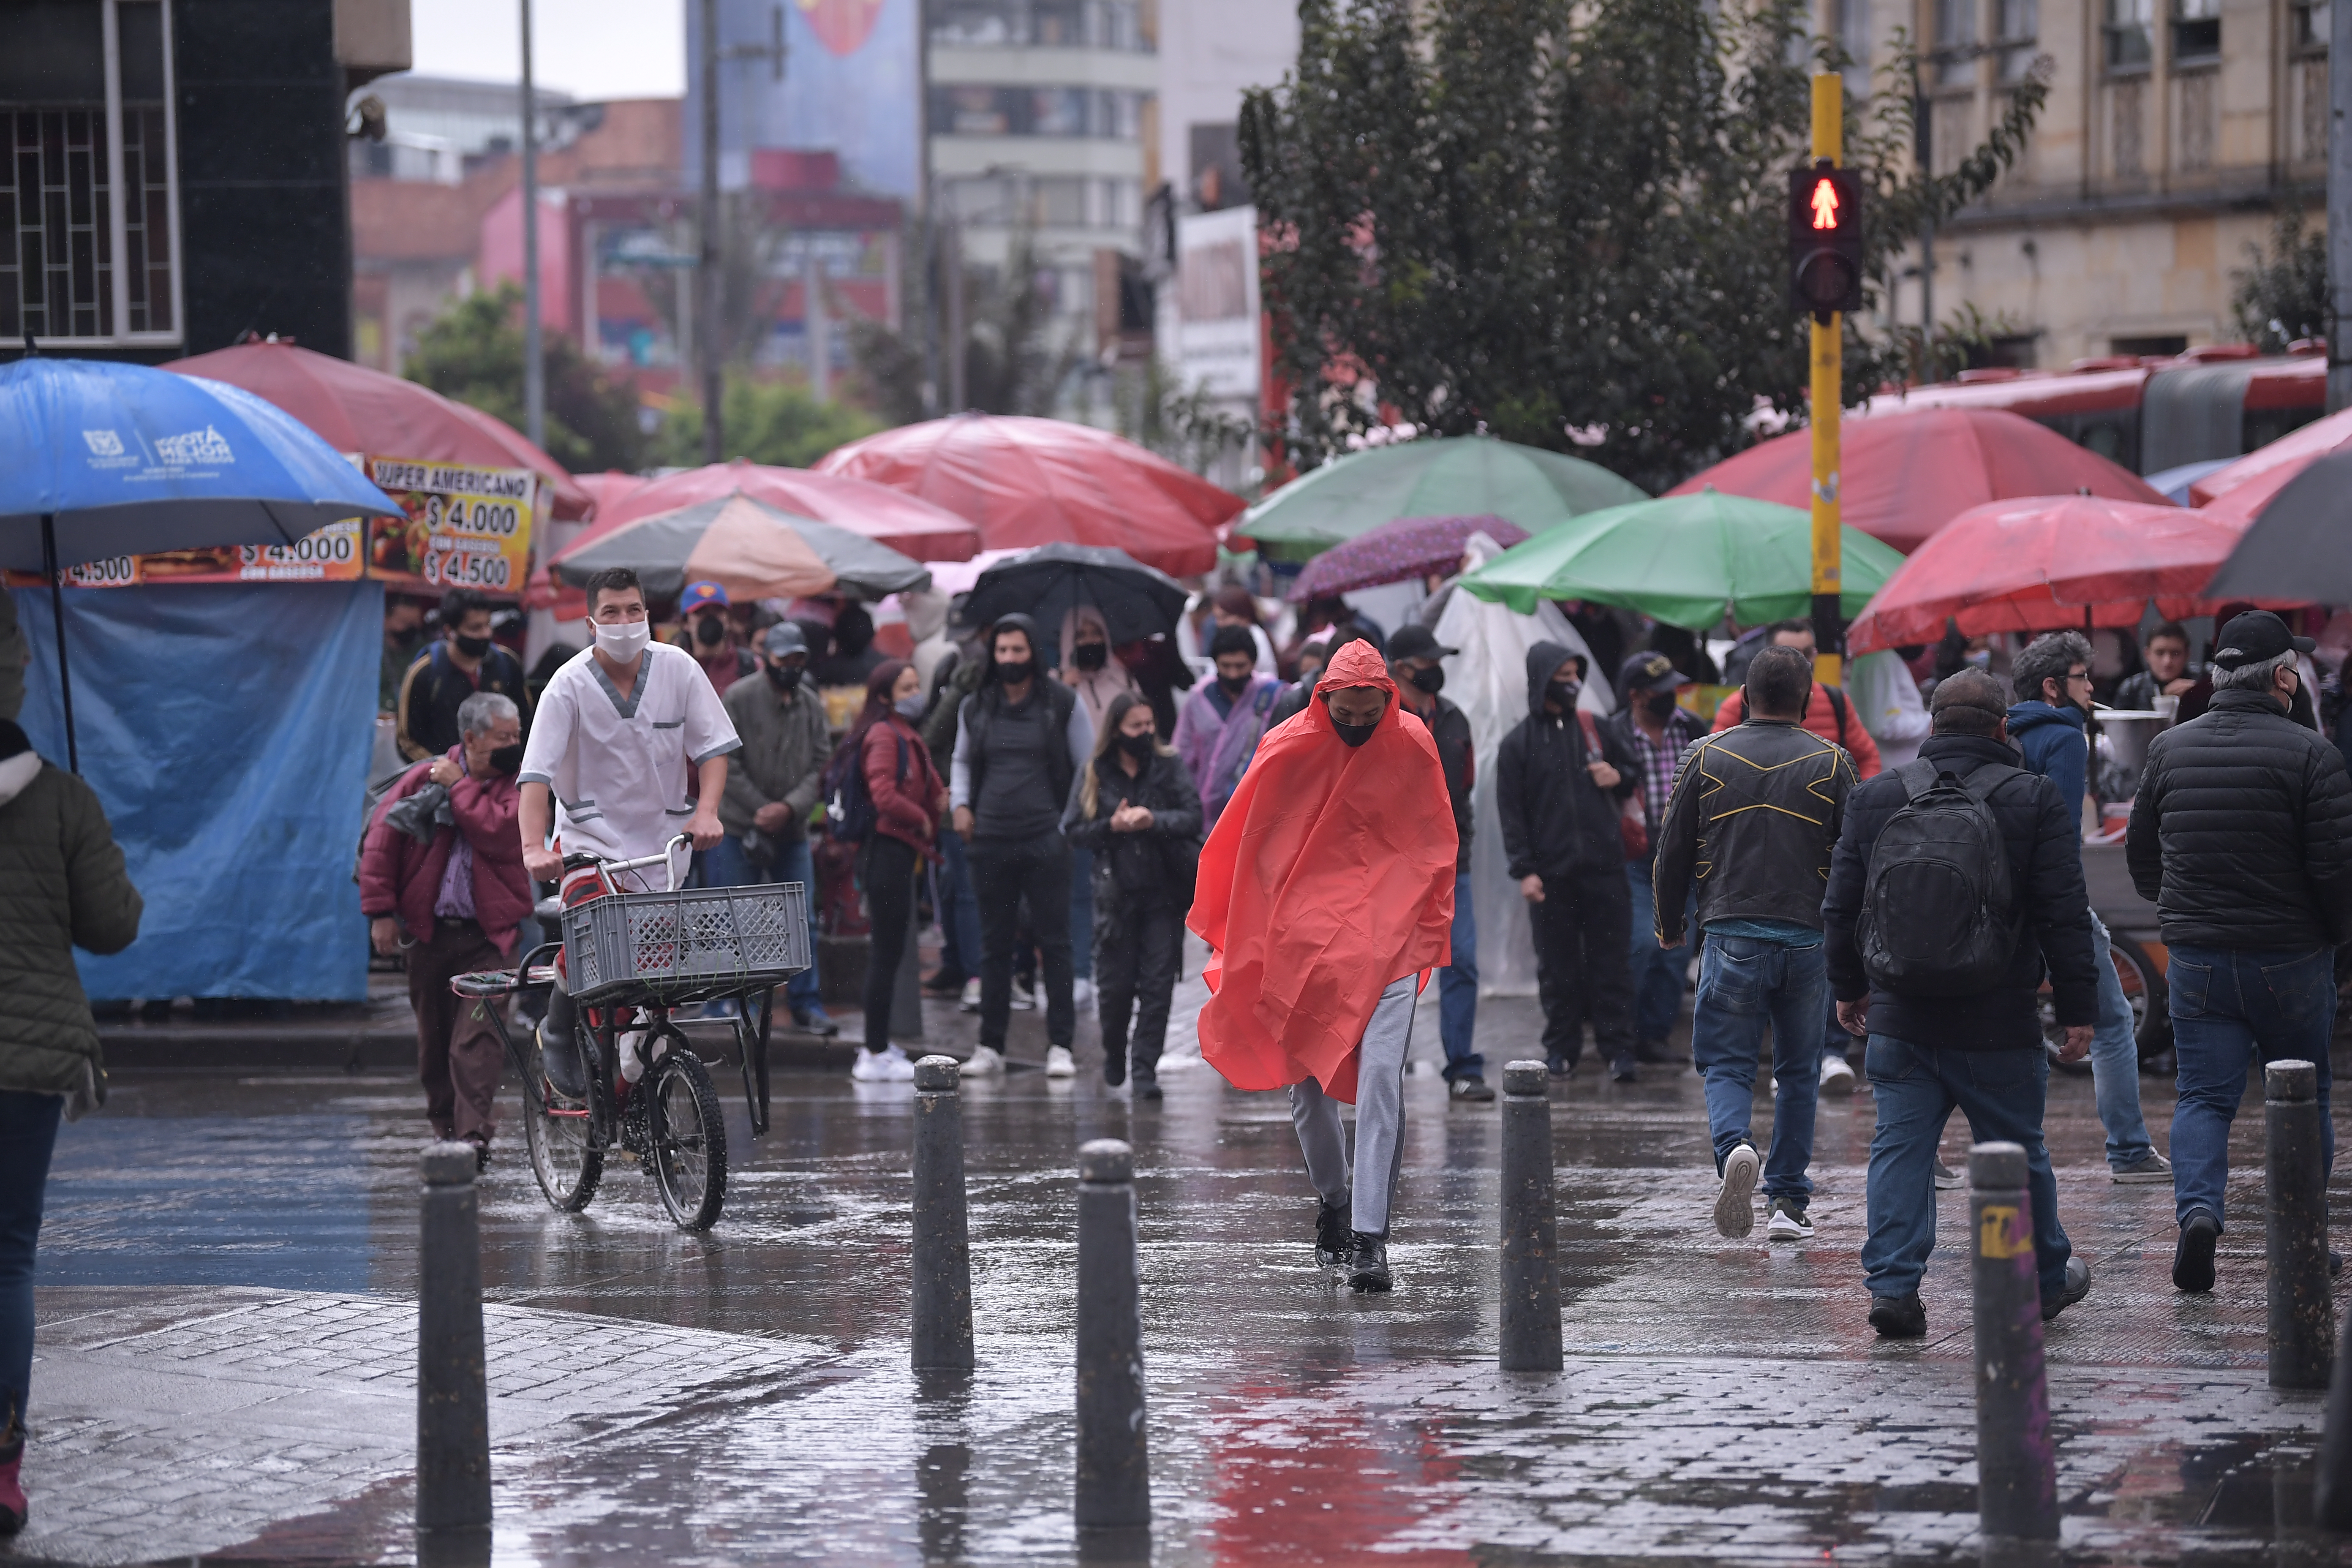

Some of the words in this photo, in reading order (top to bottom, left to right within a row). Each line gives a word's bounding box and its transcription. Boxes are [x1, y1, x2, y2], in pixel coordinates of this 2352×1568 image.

[158, 443, 231, 460] MEJOR
[378, 463, 425, 485] SUPER
[431, 470, 525, 497] AMERICANO
[429, 500, 439, 527] $
[450, 502, 515, 534] 4.000
[269, 538, 349, 560] 4.000
[72, 556, 131, 581] 4.500
[427, 555, 437, 578] $
[447, 556, 506, 585] 4.500
